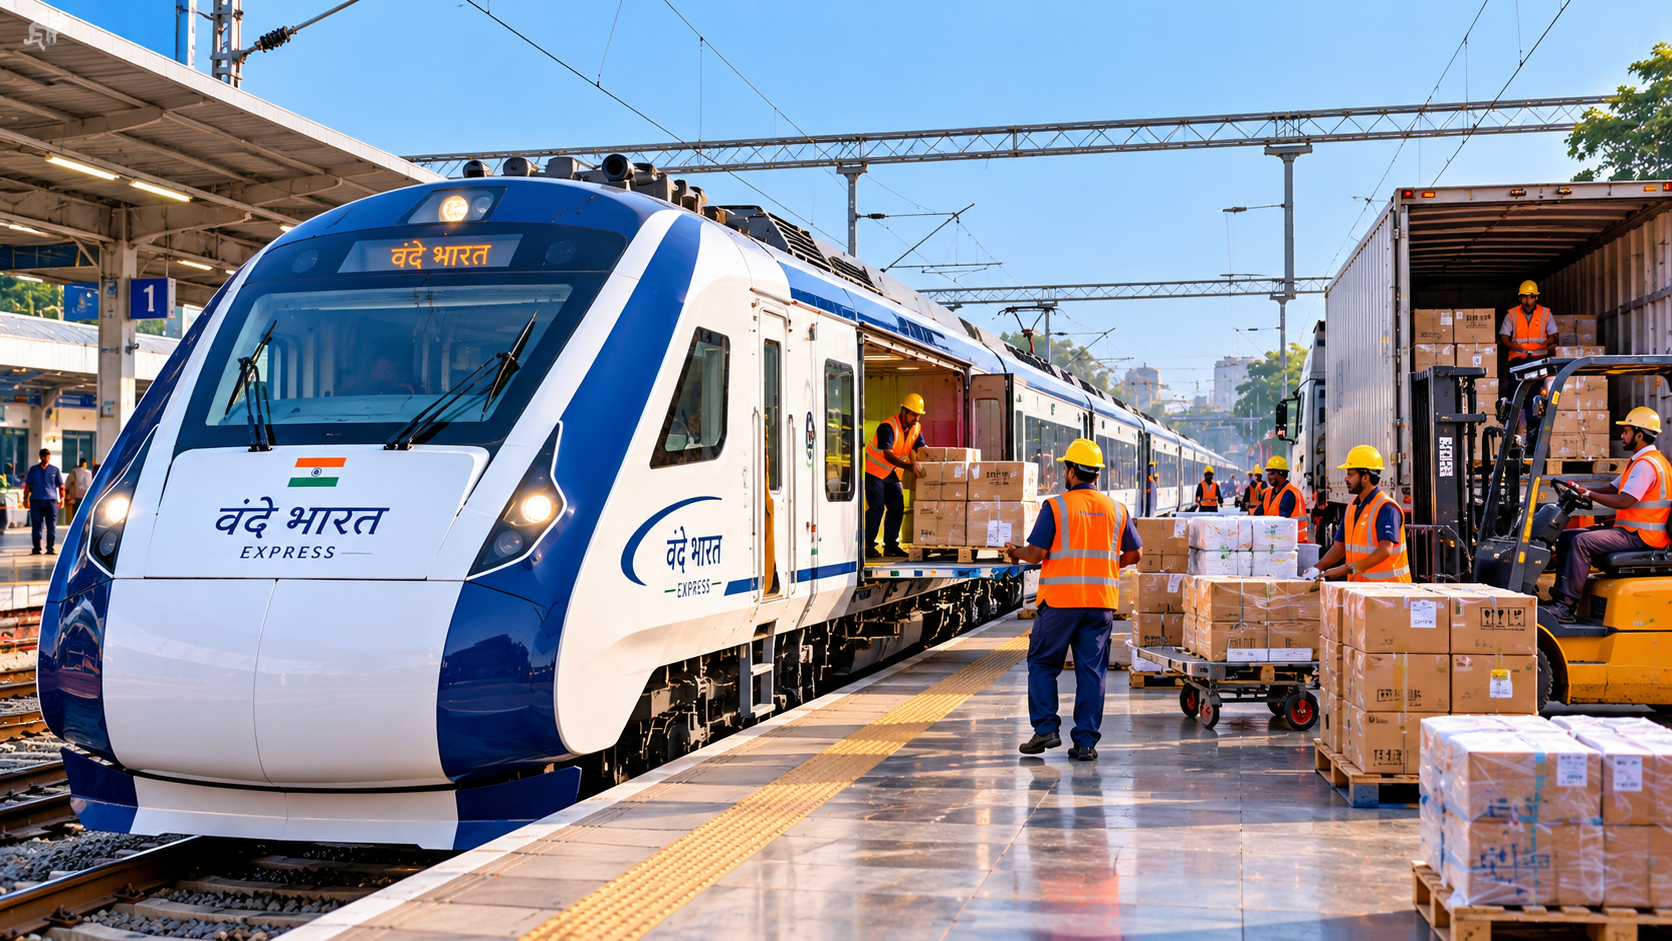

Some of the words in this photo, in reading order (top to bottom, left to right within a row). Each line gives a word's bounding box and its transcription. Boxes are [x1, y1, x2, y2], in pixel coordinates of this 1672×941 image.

[391, 239, 427, 269] वंदे
[433, 244, 492, 266] भारत
[143, 284, 155, 312] 1
[215, 496, 279, 539] वंदे
[287, 506, 390, 535] भारत
[239, 546, 336, 559] EXPRESS
[666, 525, 688, 574] वंदे
[691, 535, 723, 567] भारत
[677, 578, 710, 598] EXPRESS
